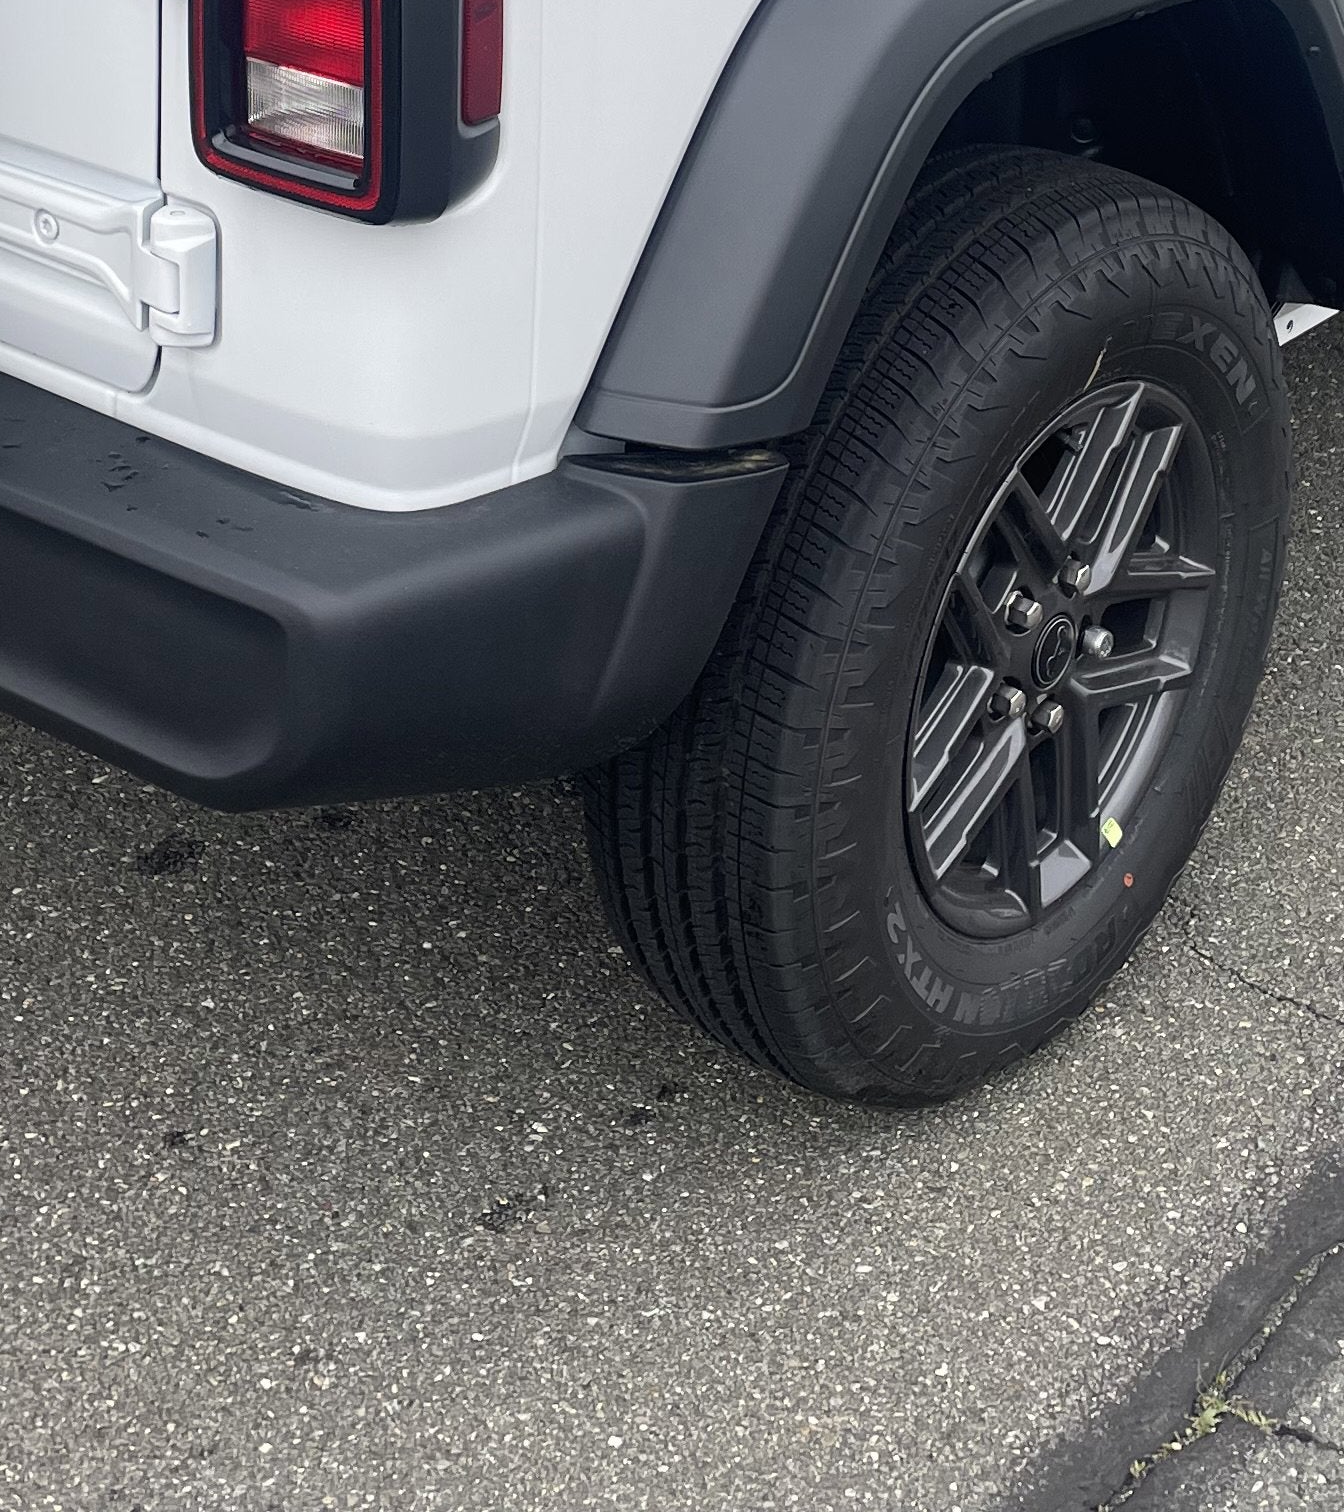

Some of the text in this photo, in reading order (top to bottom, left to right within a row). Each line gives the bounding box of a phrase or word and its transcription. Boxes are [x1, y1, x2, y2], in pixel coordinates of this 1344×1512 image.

[1120, 310, 1257, 406] NEXEN
[885, 900, 907, 945] 2
[897, 935, 955, 1014] HTX
